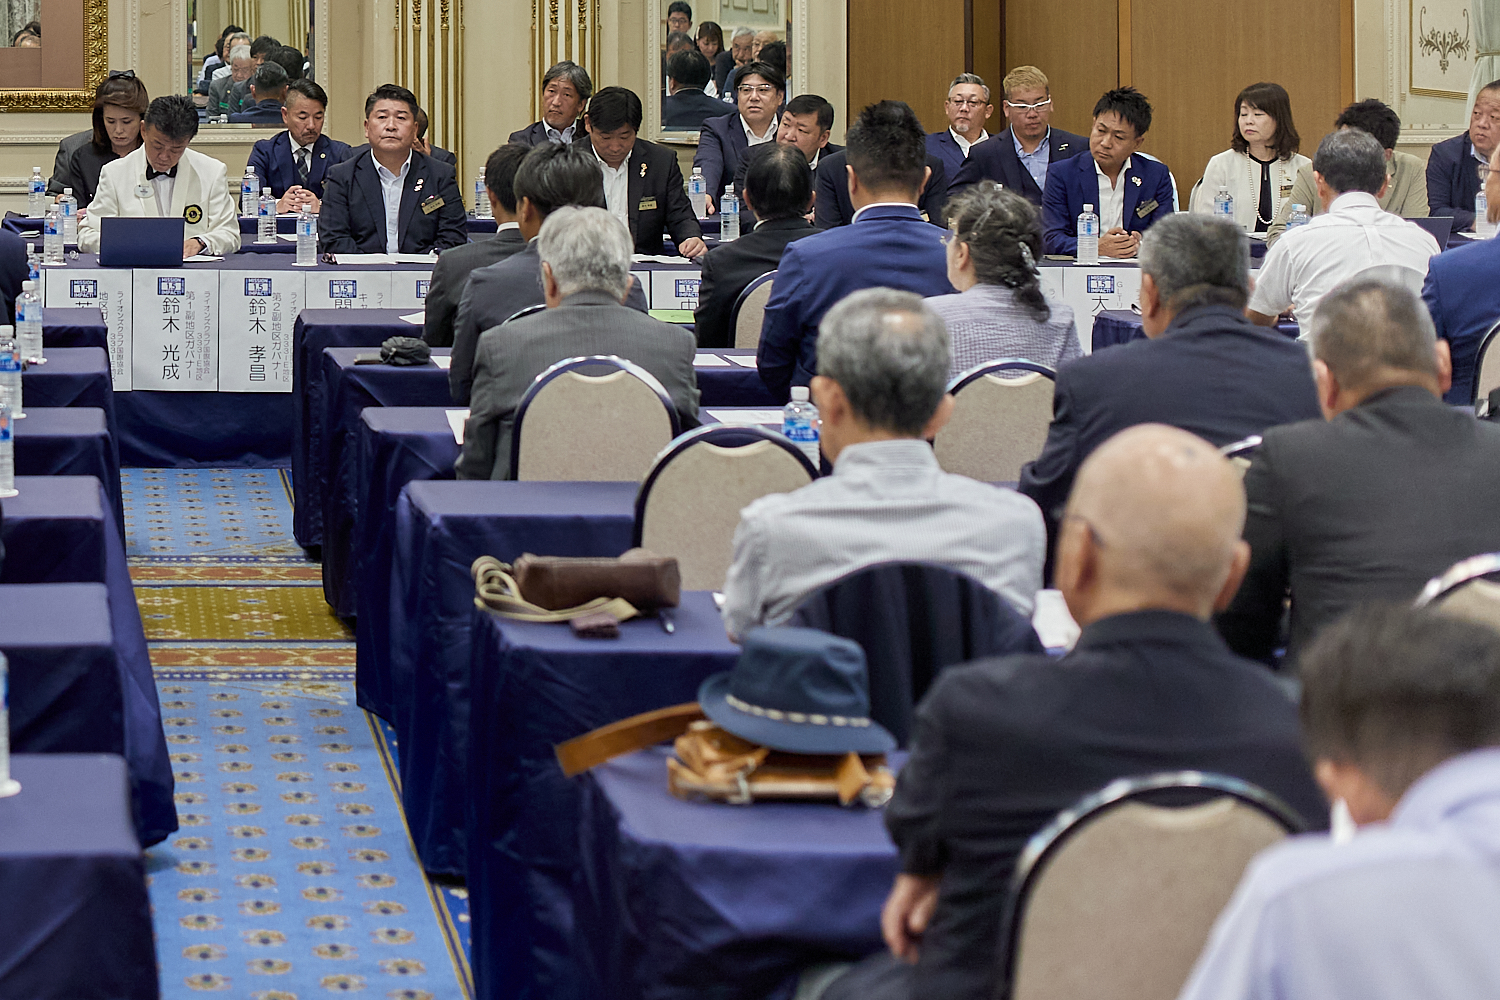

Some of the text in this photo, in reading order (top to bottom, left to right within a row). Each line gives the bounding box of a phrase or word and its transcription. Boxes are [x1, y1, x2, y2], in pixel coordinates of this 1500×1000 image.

[162, 296, 180, 381] 鈴木 光成
[249, 298, 267, 381] 鈴木 孝昌
